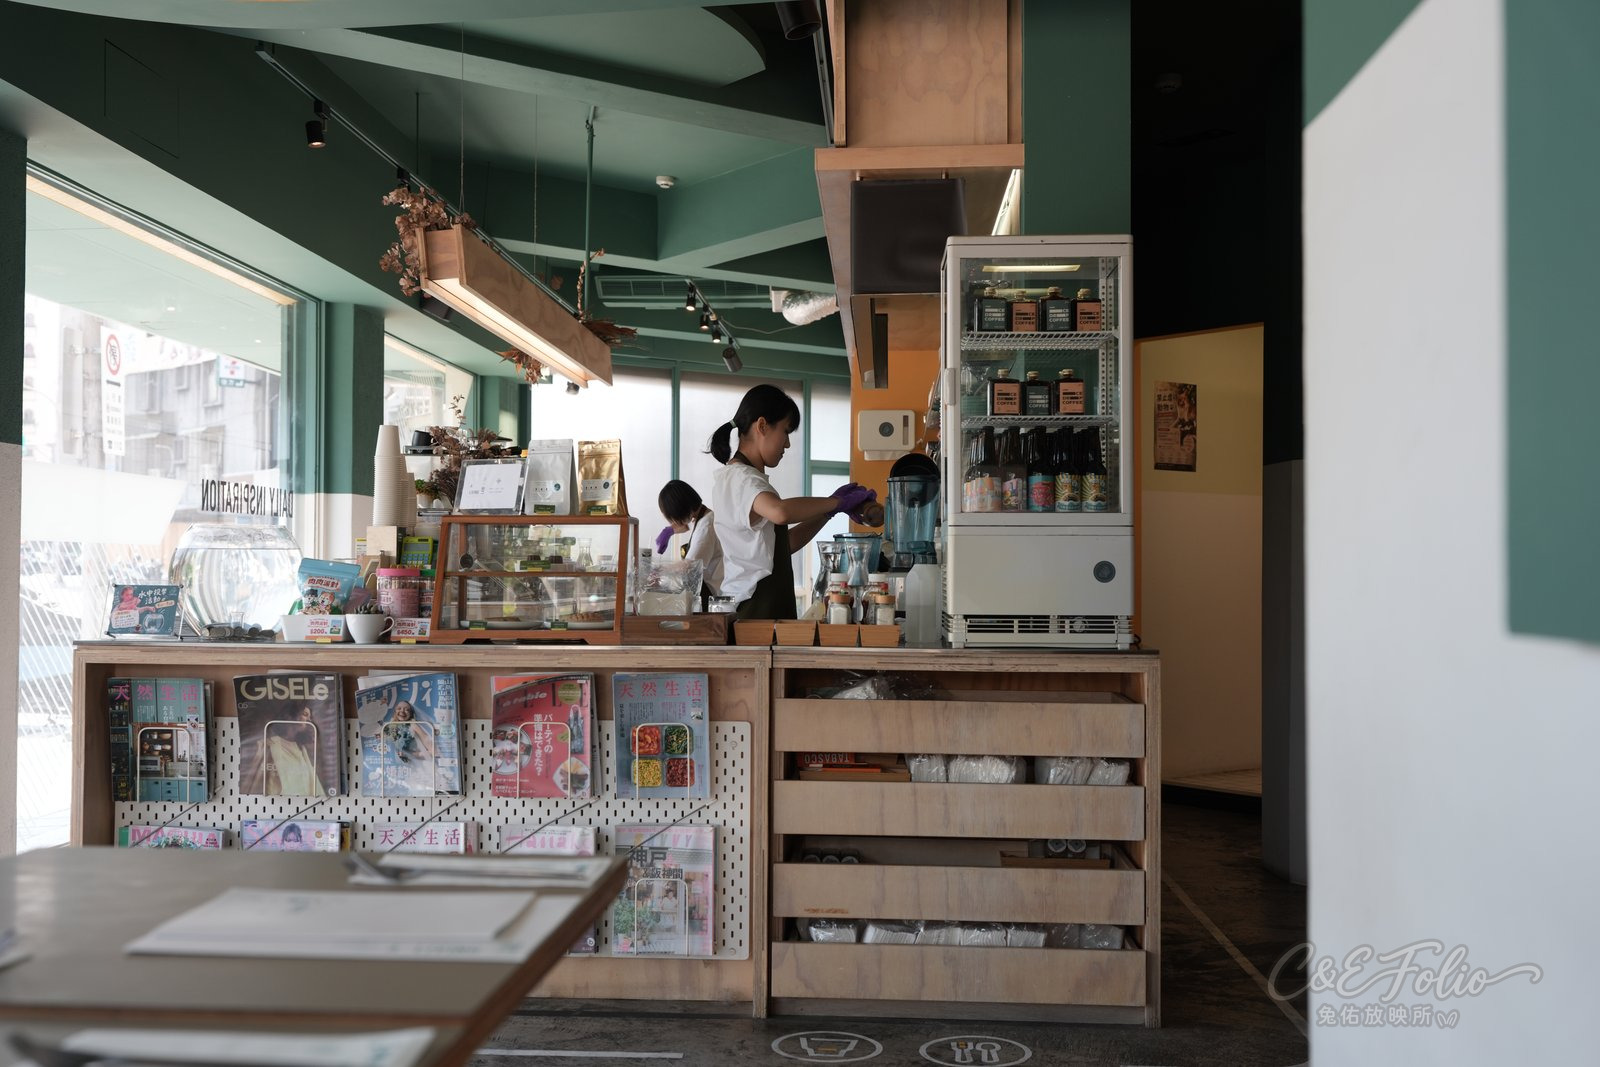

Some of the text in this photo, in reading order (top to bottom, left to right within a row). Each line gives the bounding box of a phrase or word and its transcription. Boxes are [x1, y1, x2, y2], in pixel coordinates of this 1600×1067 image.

[112, 684, 199, 700] 天然生活
[240, 677, 329, 700] GISELe
[619, 680, 703, 698] 天然生活
[543, 714, 554, 753] パーティの
[804, 753, 849, 764] TABASCO
[378, 829, 460, 846] 天然生活
